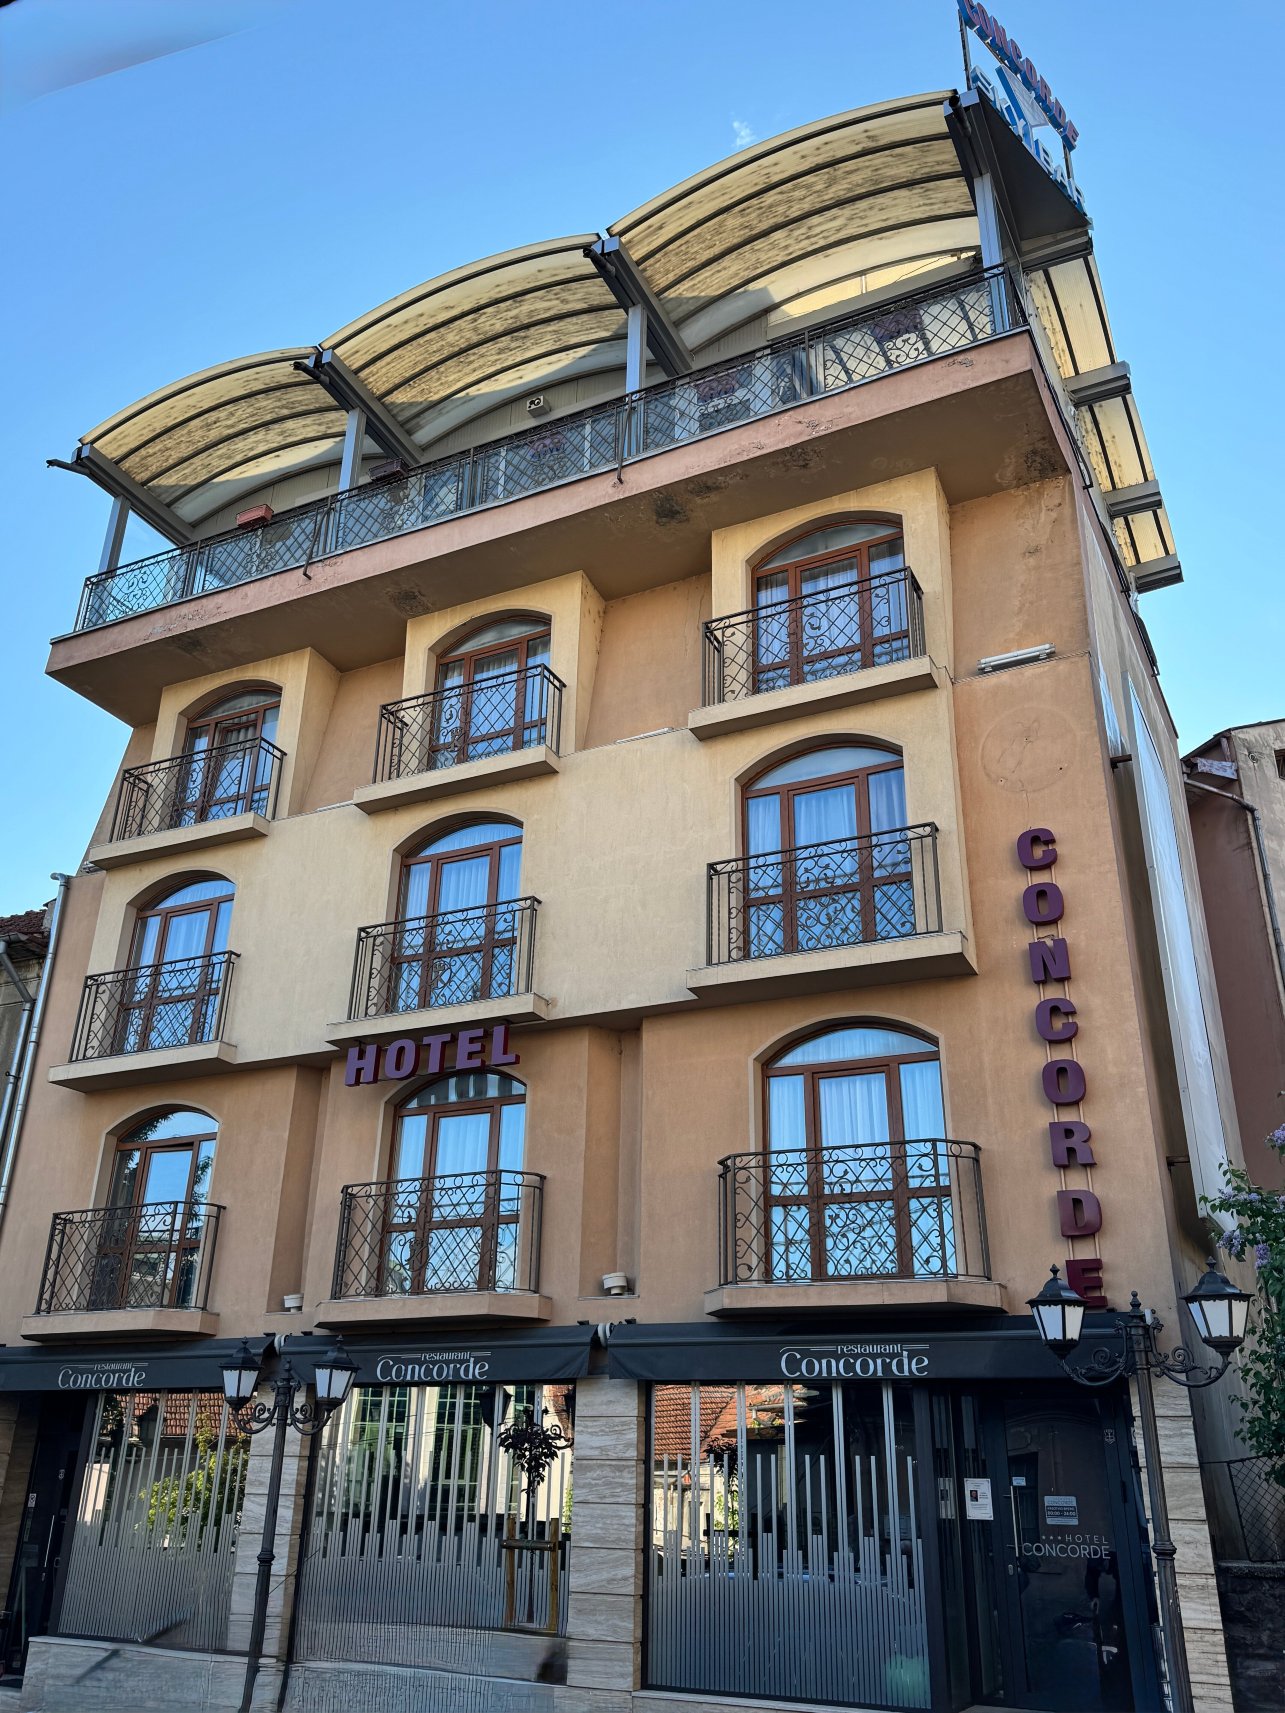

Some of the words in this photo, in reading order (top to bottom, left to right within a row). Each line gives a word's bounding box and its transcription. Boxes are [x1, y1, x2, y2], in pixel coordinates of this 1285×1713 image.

[956, 0, 1079, 151] CONCORDE
[345, 1024, 521, 1087] HOTEL
[1016, 827, 1109, 1308] CONCORDE
[421, 1351, 471, 1361] restaurant
[837, 1343, 902, 1354] restaurant
[94, 1362, 133, 1371] restaurant
[376, 1357, 490, 1382] Concorde
[780, 1350, 929, 1378] Concorde
[58, 1367, 146, 1389] Concorde
[1065, 1534, 1109, 1544] HOTEL
[1022, 1542, 1111, 1559] CONCORDE
